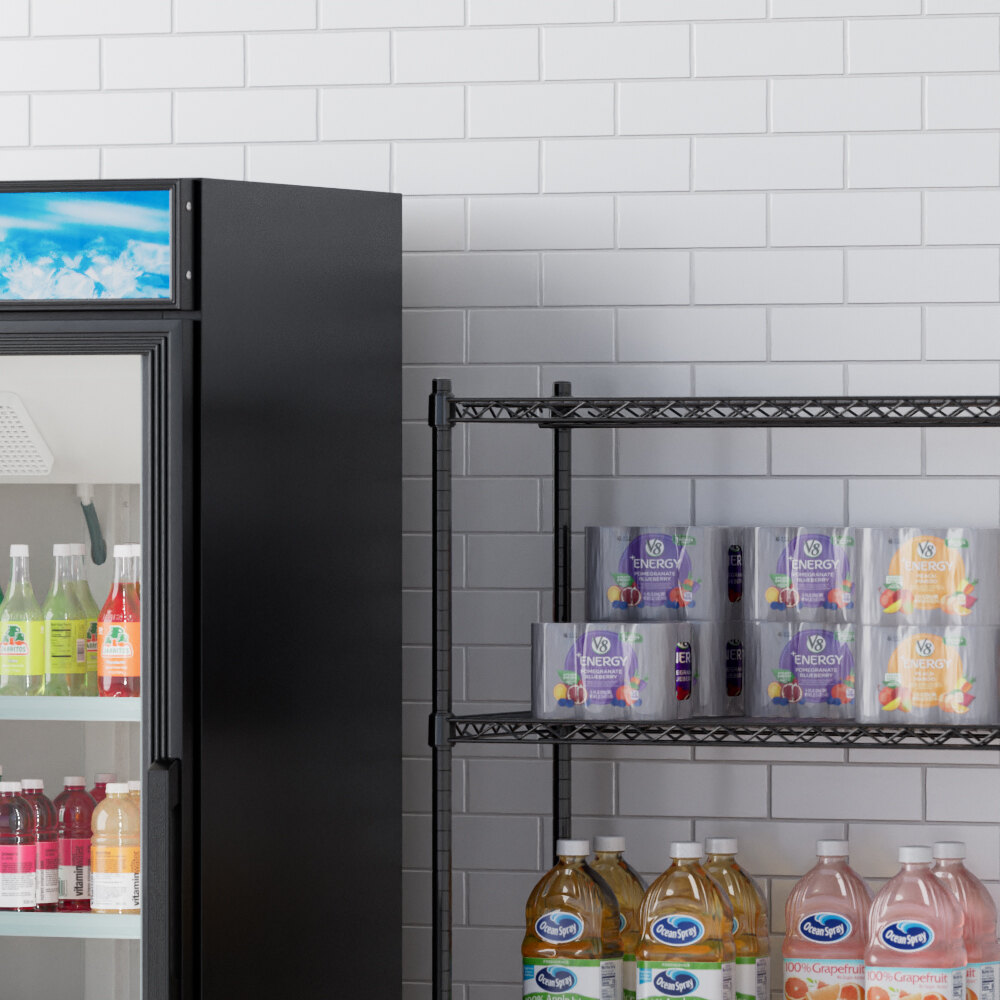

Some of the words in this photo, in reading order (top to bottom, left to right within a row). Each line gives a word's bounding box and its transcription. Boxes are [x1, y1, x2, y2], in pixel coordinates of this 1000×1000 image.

[646, 538, 662, 555] V8
[805, 538, 820, 556] V8
[918, 540, 934, 557] V8
[593, 636, 608, 653] V8
[808, 634, 824, 651] V8
[917, 638, 932, 655] V8
[540, 921, 559, 936] Ocean
[559, 923, 577, 938] Spray
[656, 924, 677, 938] Ocean
[677, 926, 697, 941] Spray
[803, 922, 824, 936] Ocean
[824, 924, 845, 939] Spray
[885, 930, 907, 944] Ocean
[907, 932, 927, 947] Spray
[785, 962, 812, 973] 100%
[538, 973, 556, 987] Ocean
[556, 975, 573, 989] Spray
[656, 977, 675, 991] Ocean
[675, 978, 694, 993] Spray
[867, 971, 893, 982] 100%
[894, 971, 948, 984] Grapefruit
